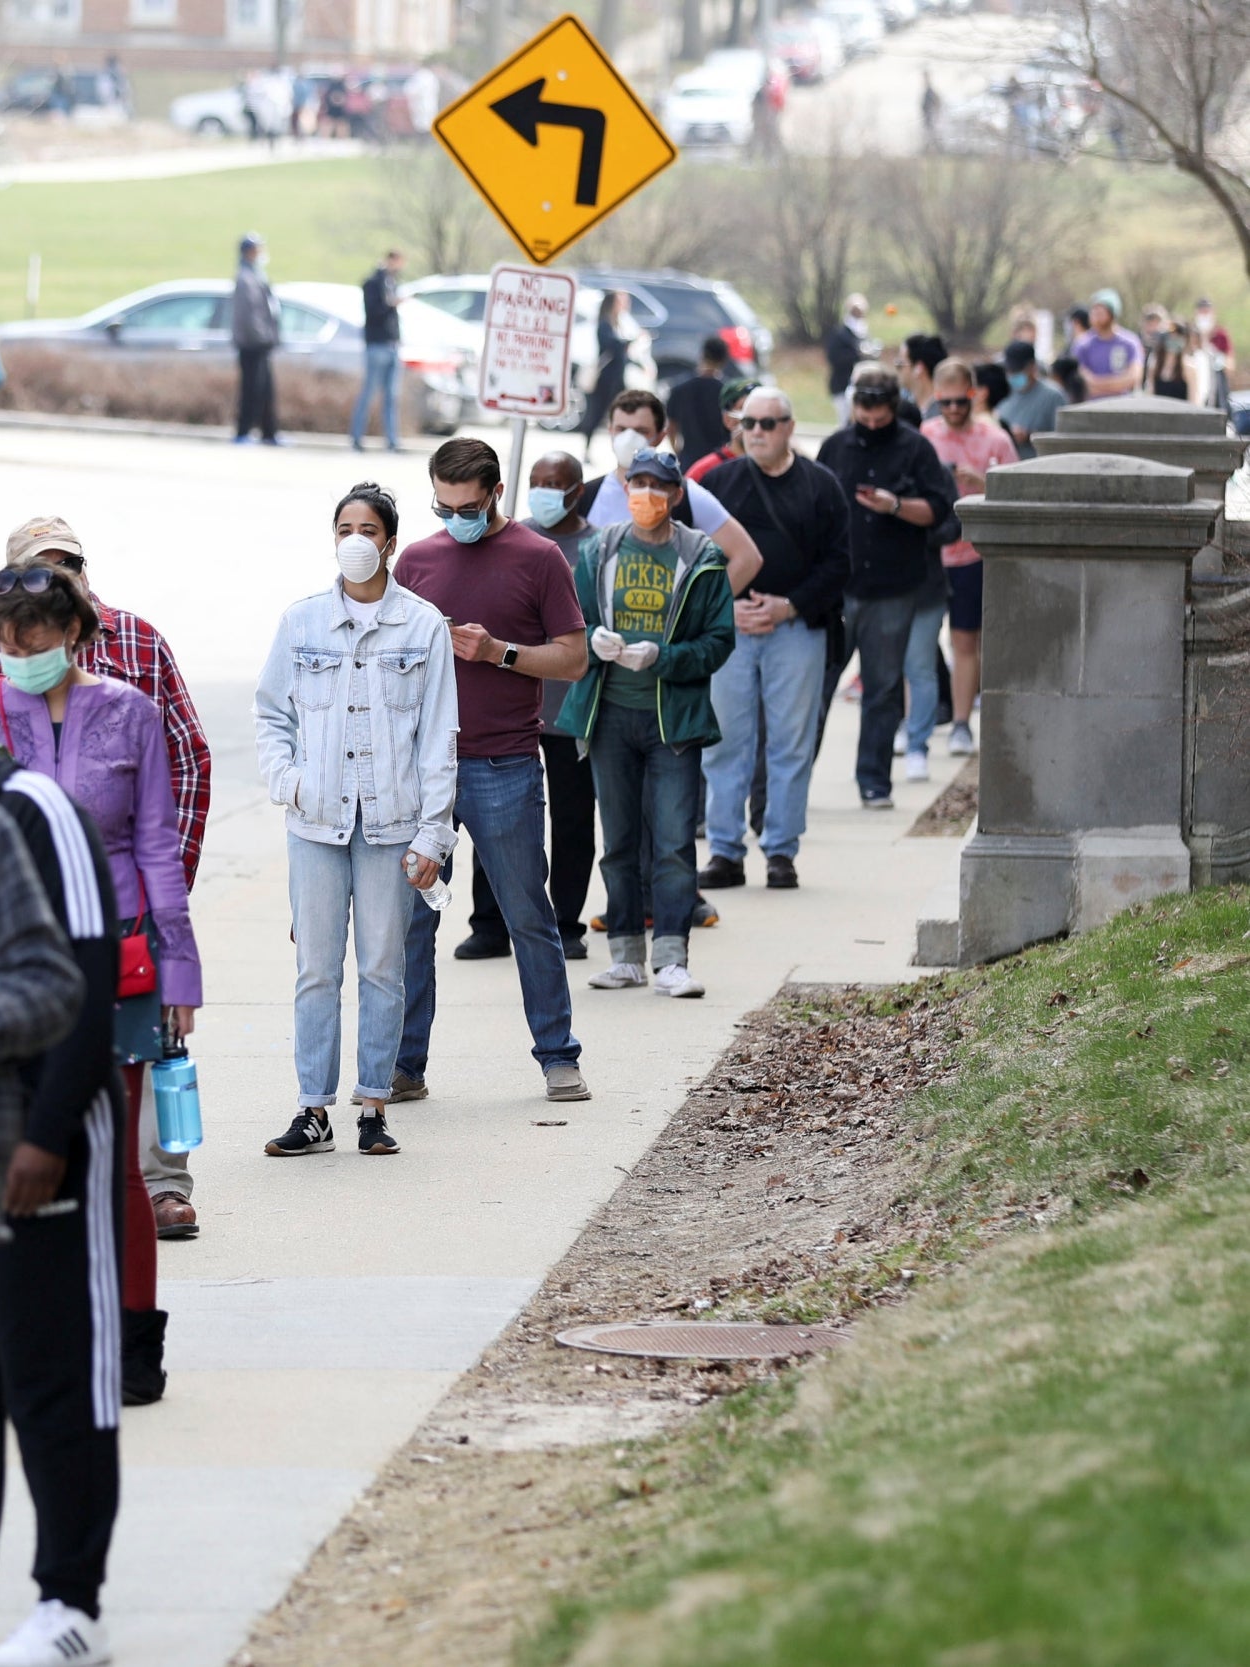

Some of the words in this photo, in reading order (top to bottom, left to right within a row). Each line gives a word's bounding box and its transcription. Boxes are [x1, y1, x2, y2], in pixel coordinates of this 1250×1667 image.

[520, 277, 542, 293] NO
[495, 290, 567, 315] PARKING
[614, 562, 675, 594] ACKER
[631, 592, 659, 607] XXL
[615, 611, 664, 633] OOTBA
